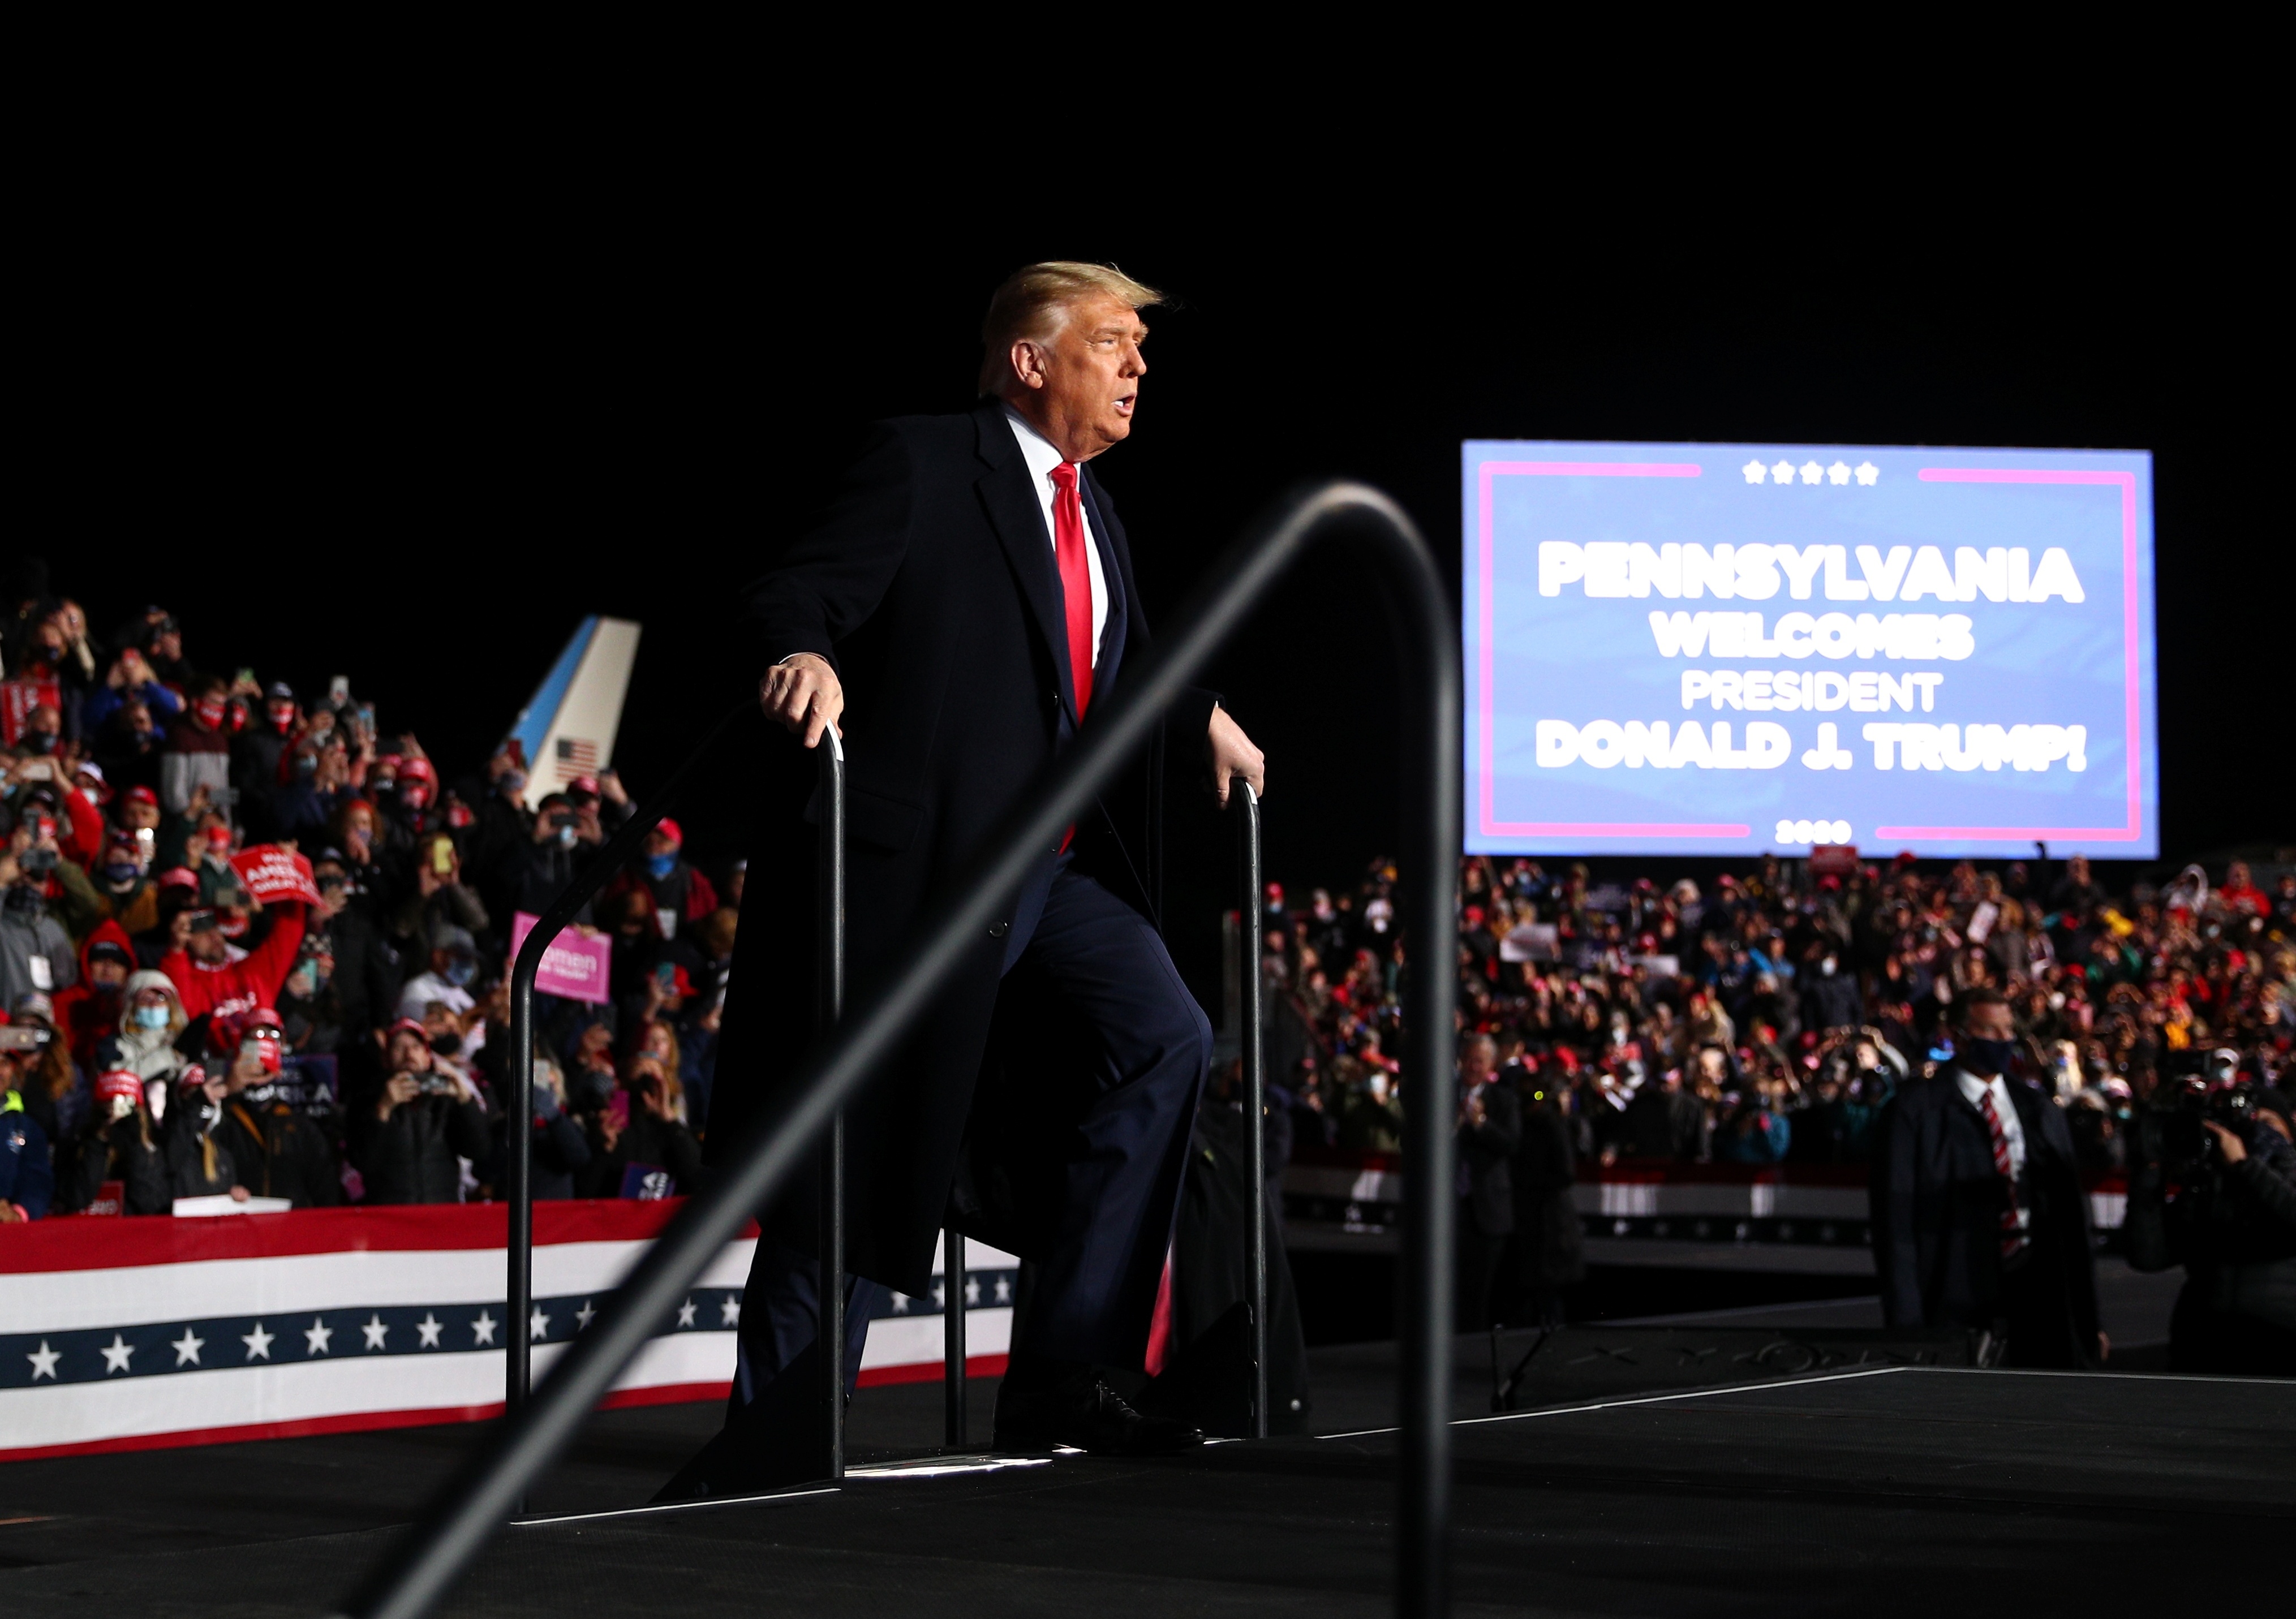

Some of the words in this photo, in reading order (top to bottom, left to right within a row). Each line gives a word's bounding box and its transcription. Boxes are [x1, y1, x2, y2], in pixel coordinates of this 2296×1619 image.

[1538, 541, 2085, 603] PENNSYLVANIA
[1649, 611, 1975, 660] WELCOMES
[1682, 670, 1944, 712] PRESIDENT
[1536, 720, 1791, 769] DONALD
[1801, 722, 1853, 770] J.
[1863, 723, 2087, 772] TRUMP!
[539, 946, 597, 973] omen
